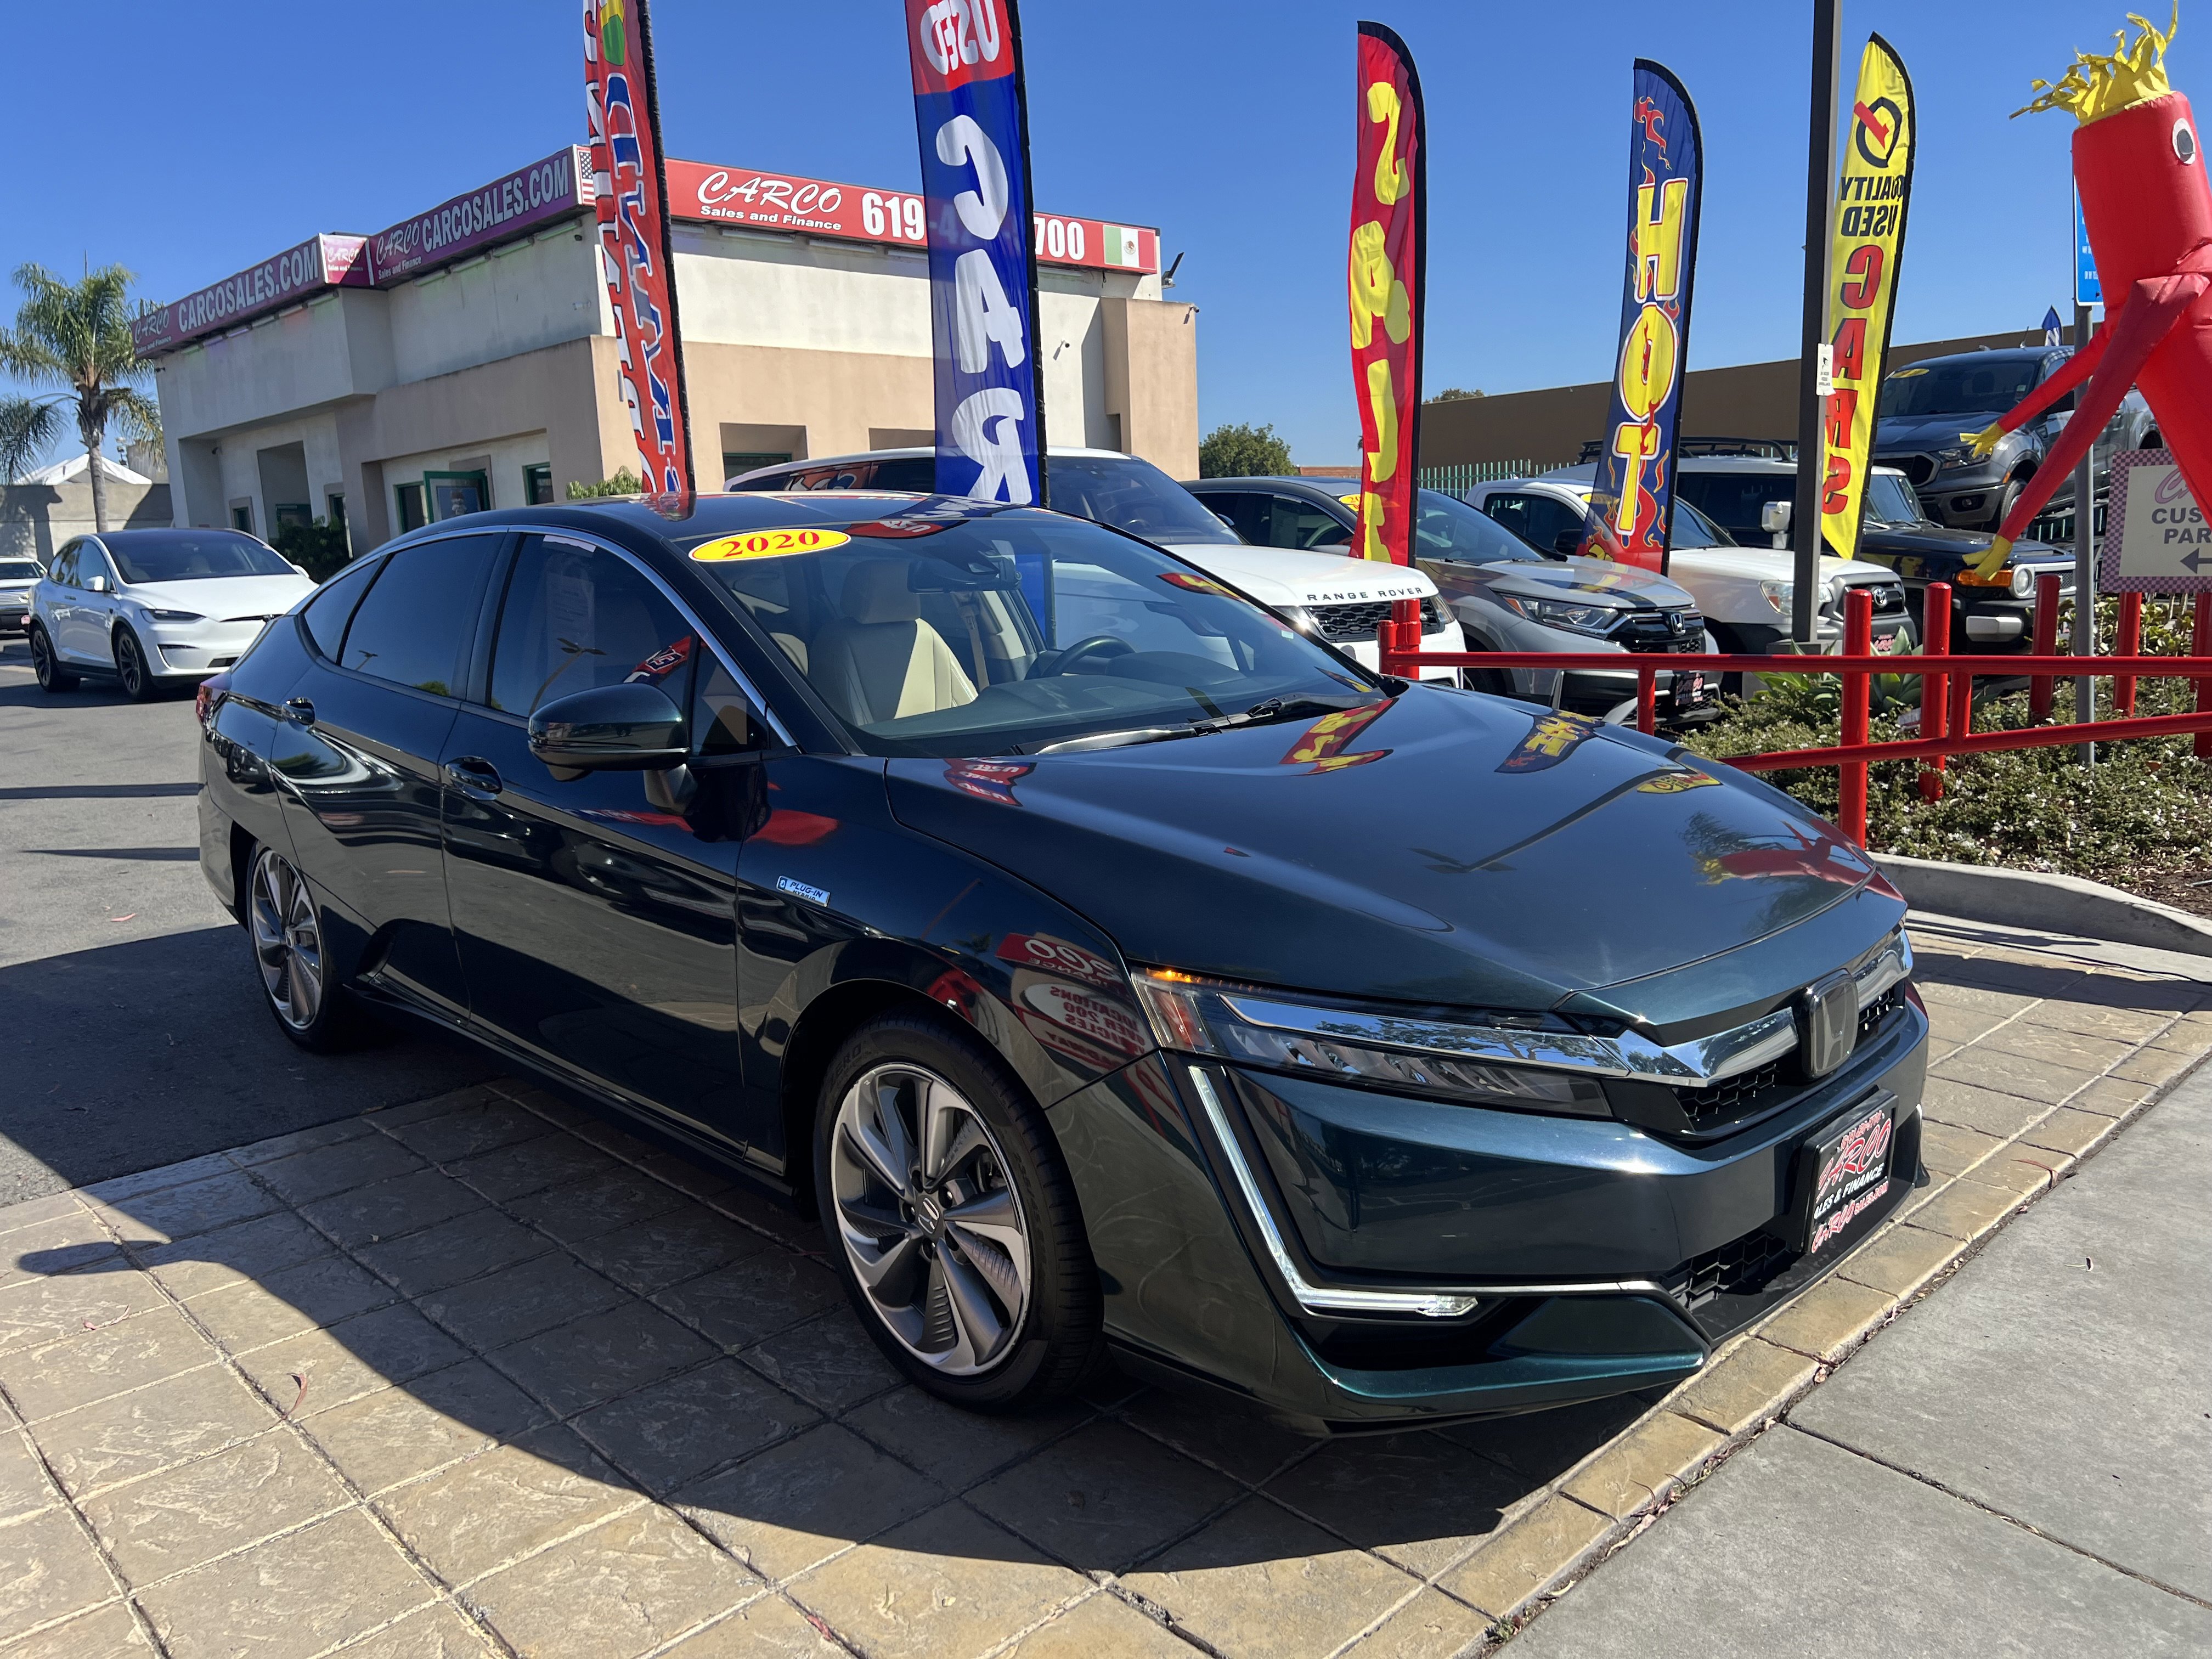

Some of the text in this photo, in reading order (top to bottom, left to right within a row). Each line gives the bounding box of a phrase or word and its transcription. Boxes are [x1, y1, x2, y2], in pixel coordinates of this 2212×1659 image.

[422, 156, 568, 253] CARCOSALES.COM
[697, 171, 842, 215] CARCO
[700, 205, 842, 230] Sales and Finance
[376, 221, 420, 266] CARCO
[378, 256, 422, 280] Sales and Finance
[178, 242, 318, 332] CARCOSALES.COM
[134, 308, 170, 345] CARCO
[2152, 507, 2203, 524] CUS
[721, 531, 820, 557] 2020
[2164, 528, 2211, 544] PAR
[1307, 586, 1423, 602] RANGE ROVER
[789, 882, 823, 898] PLUG-IN
[1815, 1118, 1891, 1204] CARCO
[1833, 1188, 1842, 1204] &
[1842, 1163, 1884, 1198] FINANCE
